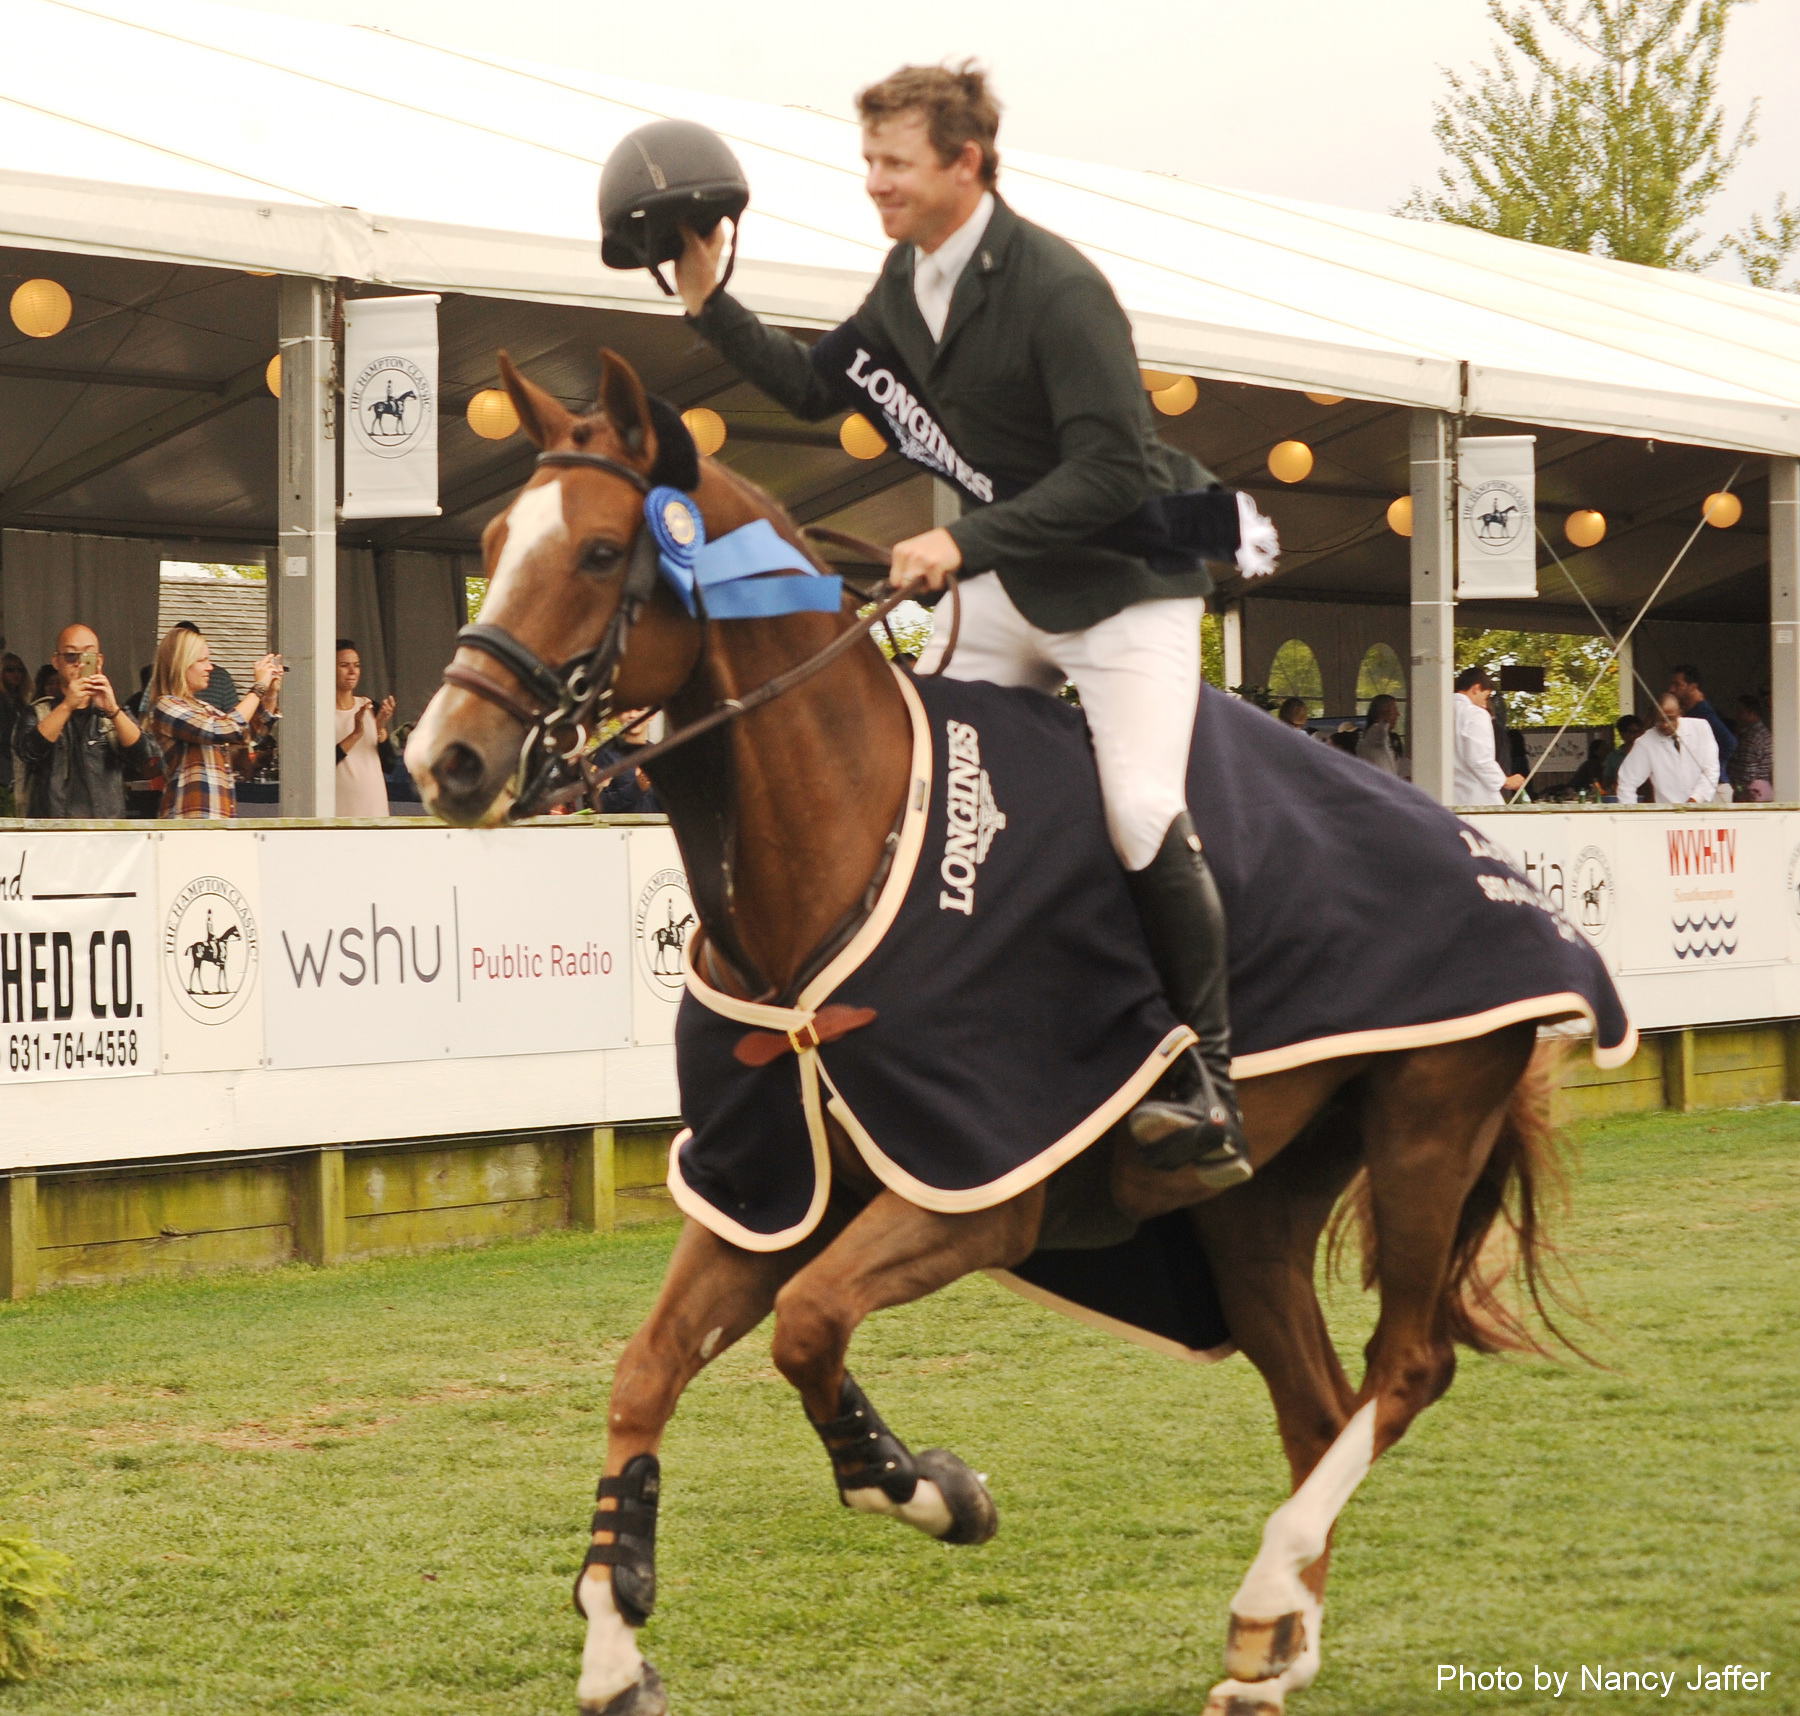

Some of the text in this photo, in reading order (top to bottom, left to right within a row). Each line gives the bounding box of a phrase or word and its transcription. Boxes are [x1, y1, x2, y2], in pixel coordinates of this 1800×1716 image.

[357, 358, 405, 388] HAMPTON
[846, 348, 994, 503] LONGINES
[939, 719, 980, 916] LONGINES
[164, 878, 259, 958] THE HAMPTON CLASSIC
[281, 902, 441, 989] wshu
[89, 929, 143, 1019] CO.
[472, 941, 613, 980] Public Radio
[10, 1028, 138, 1072] 631-764-4558
